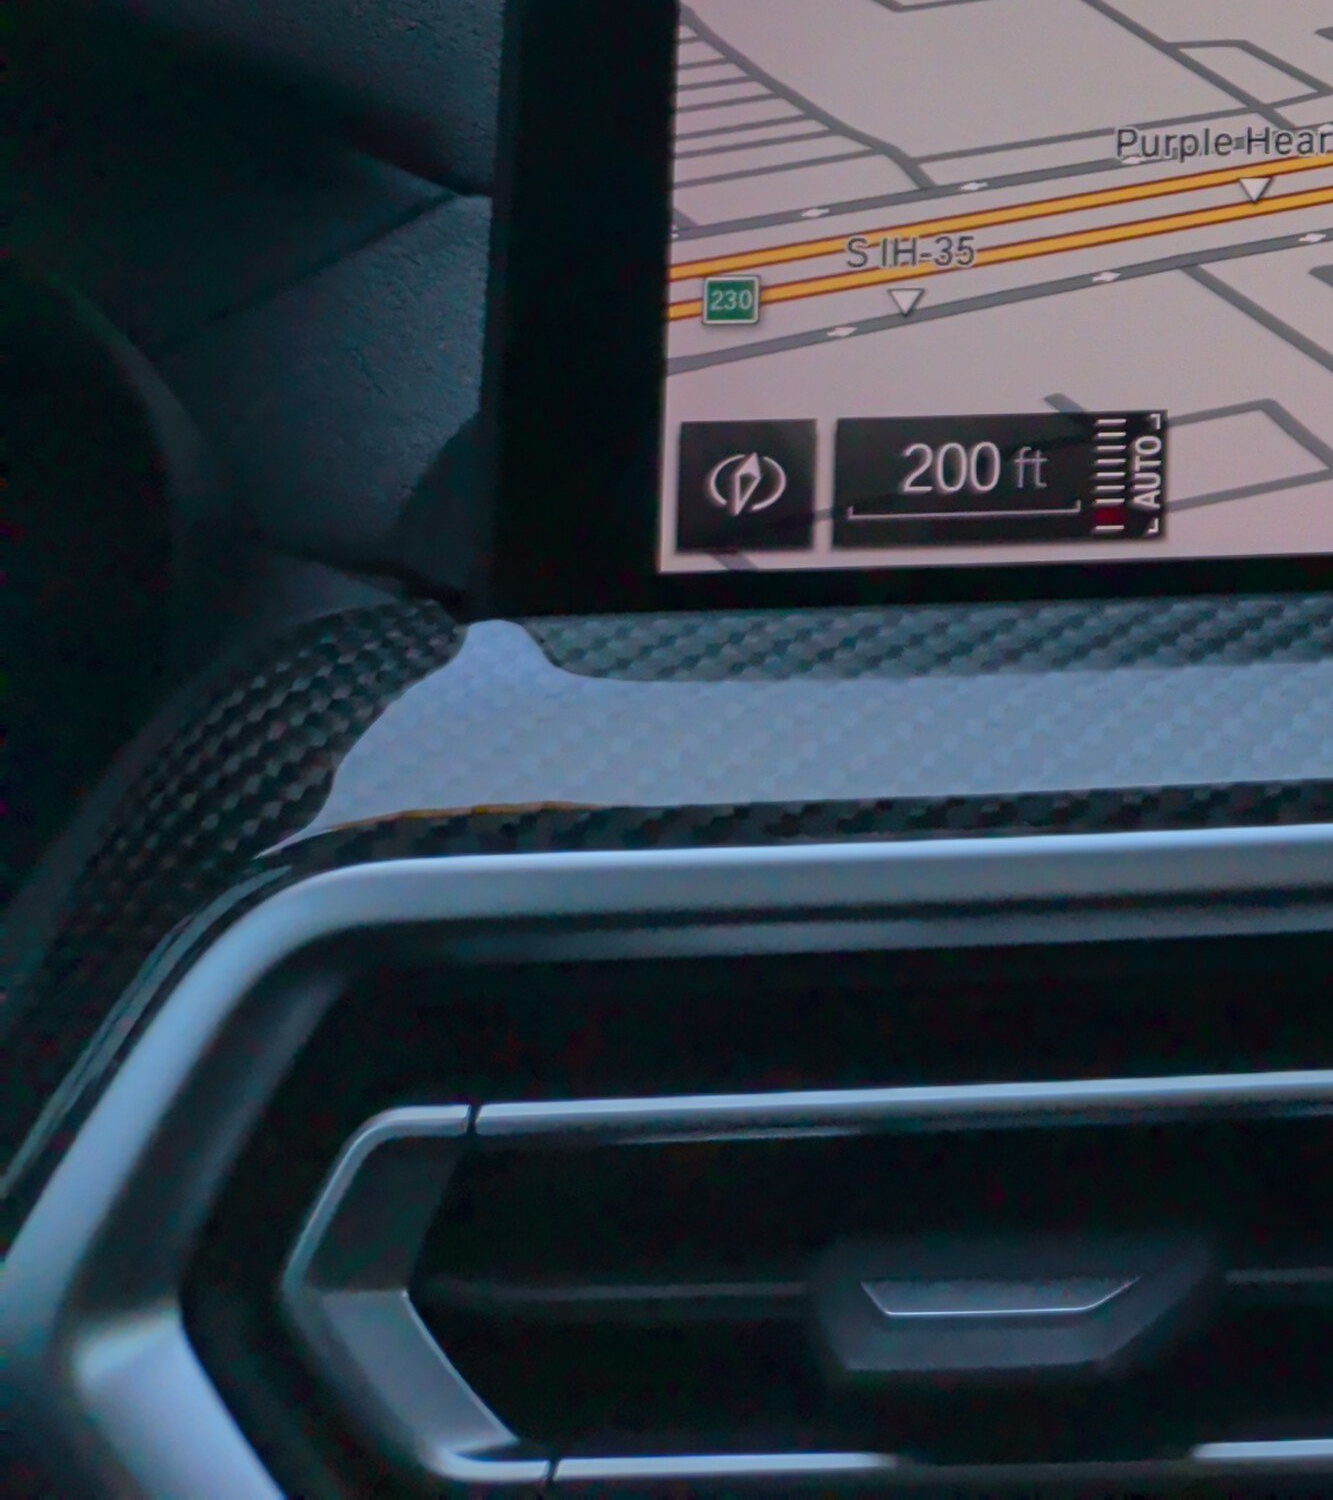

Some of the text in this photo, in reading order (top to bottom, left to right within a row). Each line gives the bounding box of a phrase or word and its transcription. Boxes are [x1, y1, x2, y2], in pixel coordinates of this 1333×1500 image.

[1116, 126, 1234, 160] Purple
[846, 235, 976, 268] S IH-35
[710, 289, 754, 311] 230
[902, 441, 1049, 494] 200 ft
[1132, 434, 1163, 510] AUTO
